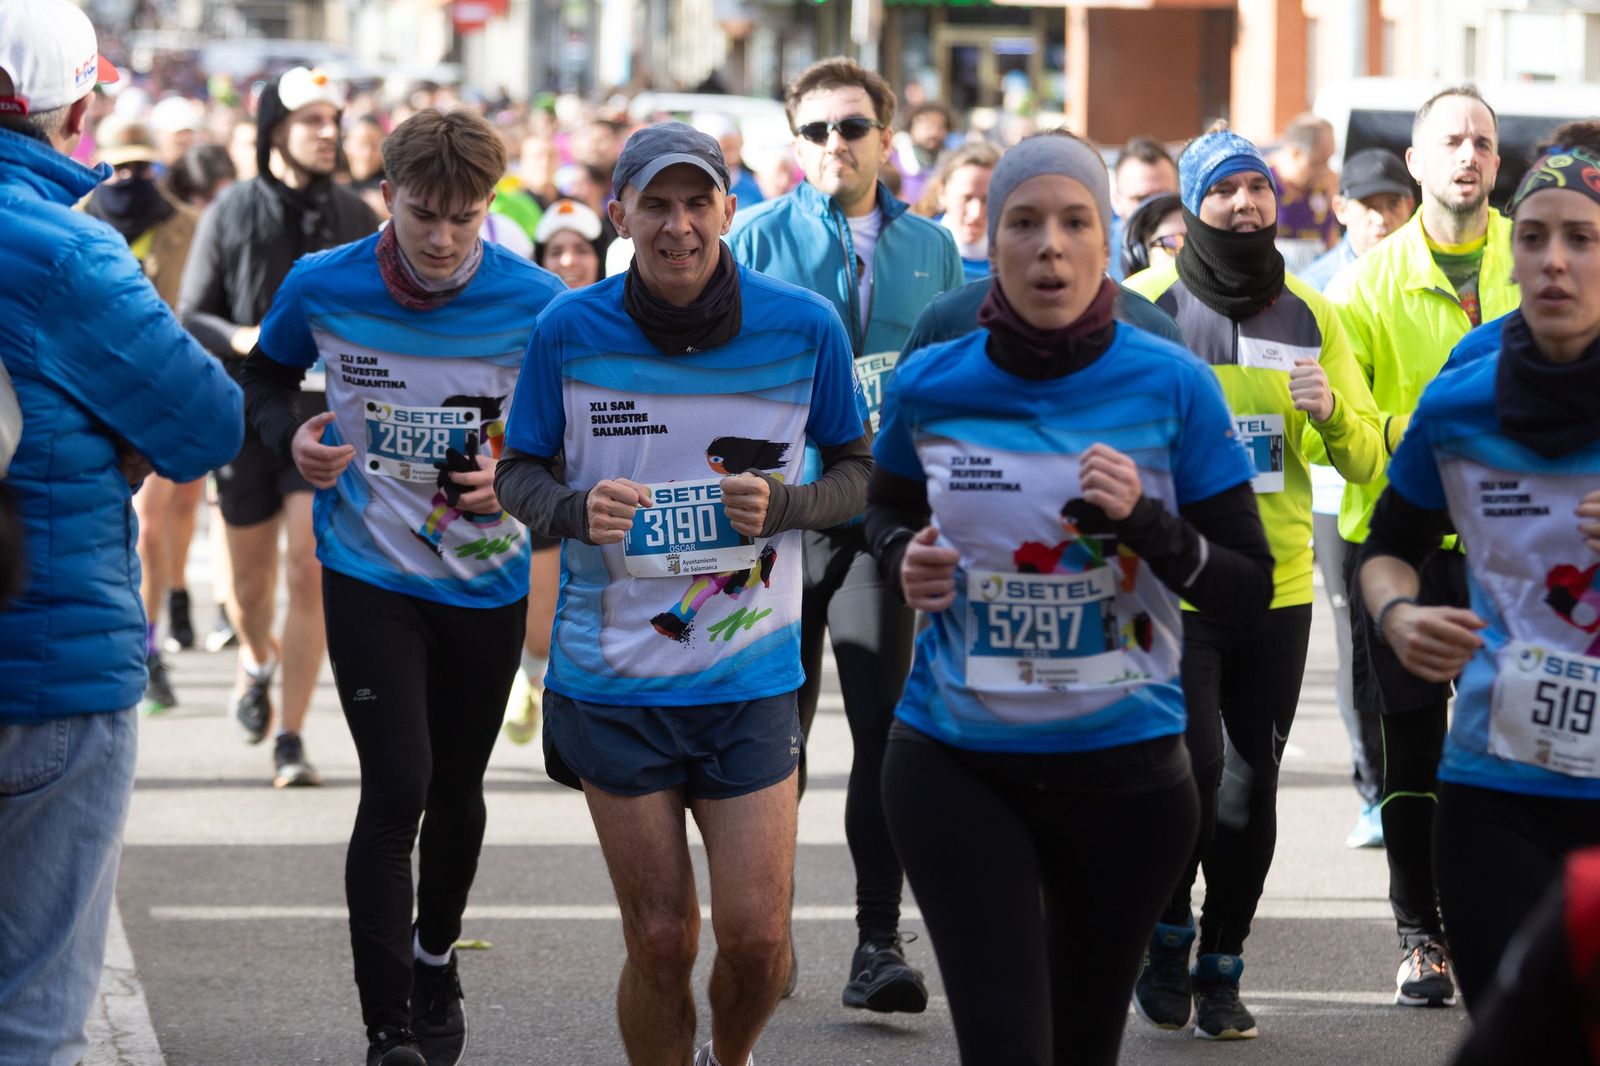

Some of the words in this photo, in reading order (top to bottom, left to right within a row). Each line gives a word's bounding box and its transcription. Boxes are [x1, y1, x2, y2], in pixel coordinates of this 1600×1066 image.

[340, 353, 354, 363] XLI
[356, 355, 379, 366] SAN
[857, 357, 894, 374] TEL
[341, 364, 390, 377] SILVESTRE
[342, 374, 407, 389] SALMANTINA
[589, 402, 607, 412] XLI
[610, 400, 635, 411] SAN
[394, 409, 468, 425] SETEL
[591, 413, 649, 425] SILVESTRE
[592, 424, 669, 437] SALMANTINA
[1237, 420, 1272, 432] TEL
[380, 424, 450, 459] 2628
[949, 481, 1022, 492] SALMANTINA
[655, 485, 721, 504] SETE
[645, 505, 717, 546] 3190
[669, 543, 696, 553] OSCAR
[682, 557, 718, 568] Ayuntamiento
[682, 565, 690, 573] de
[690, 564, 718, 573] Salamanca
[1007, 580, 1103, 599] SETEL
[989, 604, 1083, 650] 5297
[1543, 656, 1600, 684] SET
[1532, 680, 1597, 735] 519
